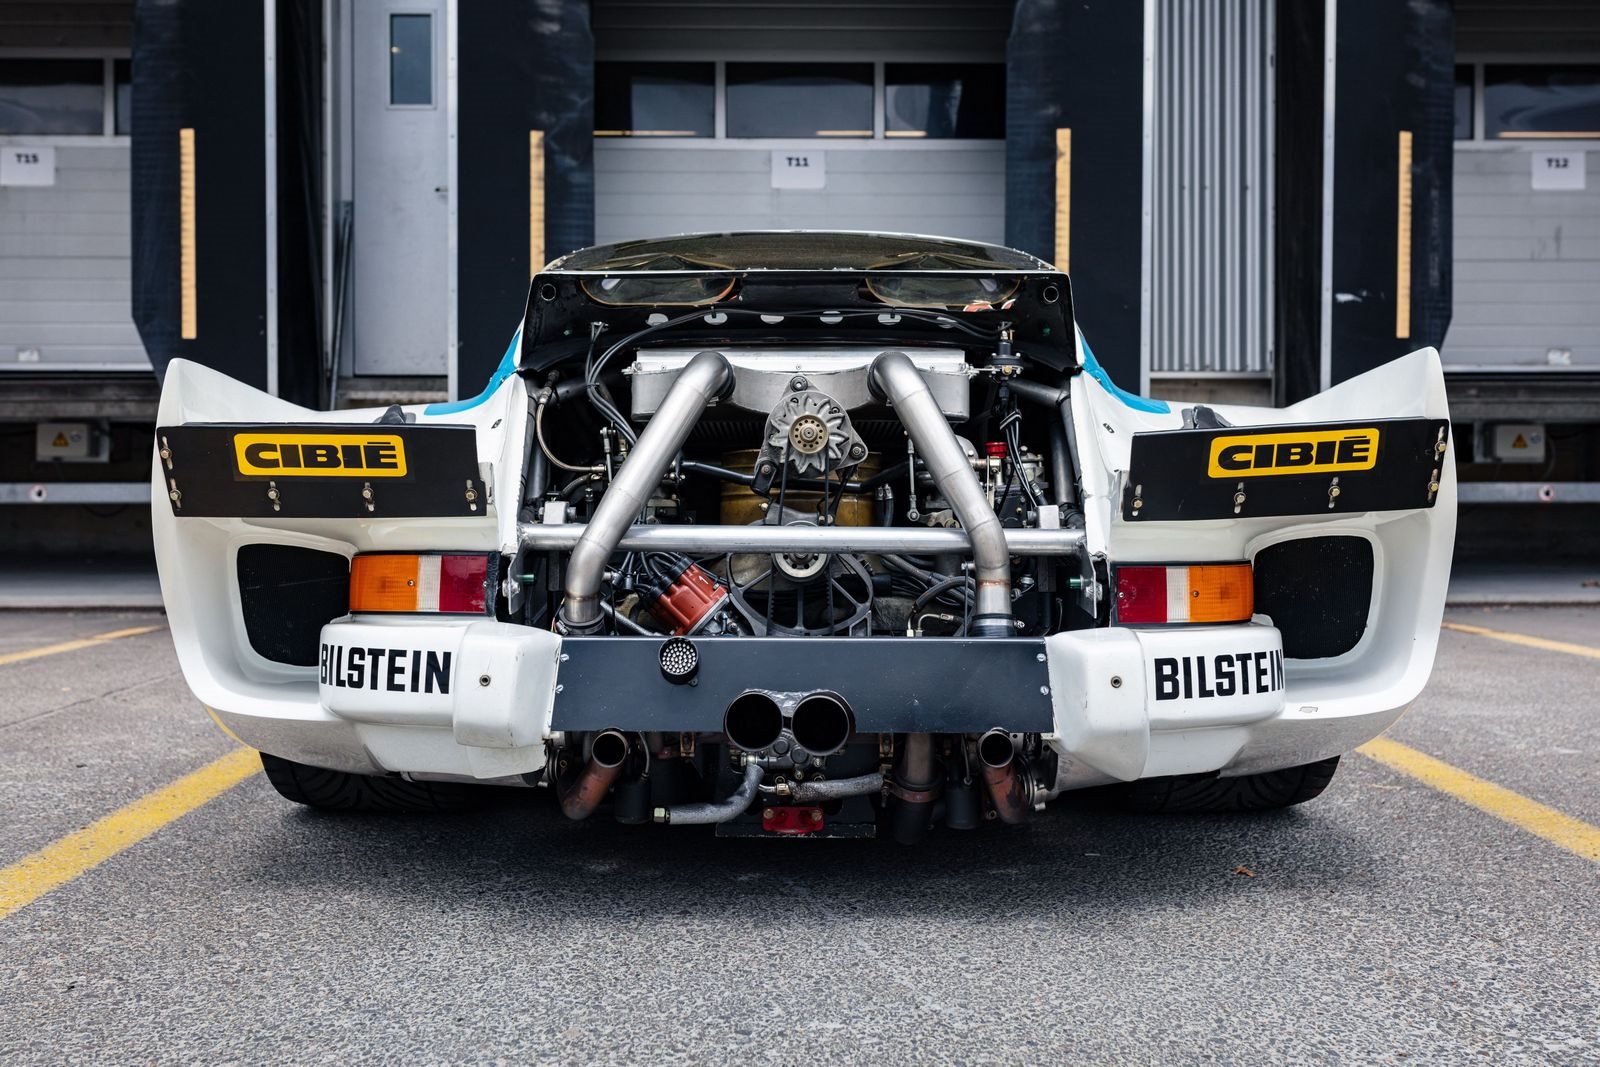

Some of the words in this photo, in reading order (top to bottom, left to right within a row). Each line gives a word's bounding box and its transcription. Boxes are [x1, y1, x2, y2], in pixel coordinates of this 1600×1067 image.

[786, 156, 809, 167] T11
[320, 643, 452, 694] BILSTEIN
[1154, 649, 1284, 701] BILSTEIN
